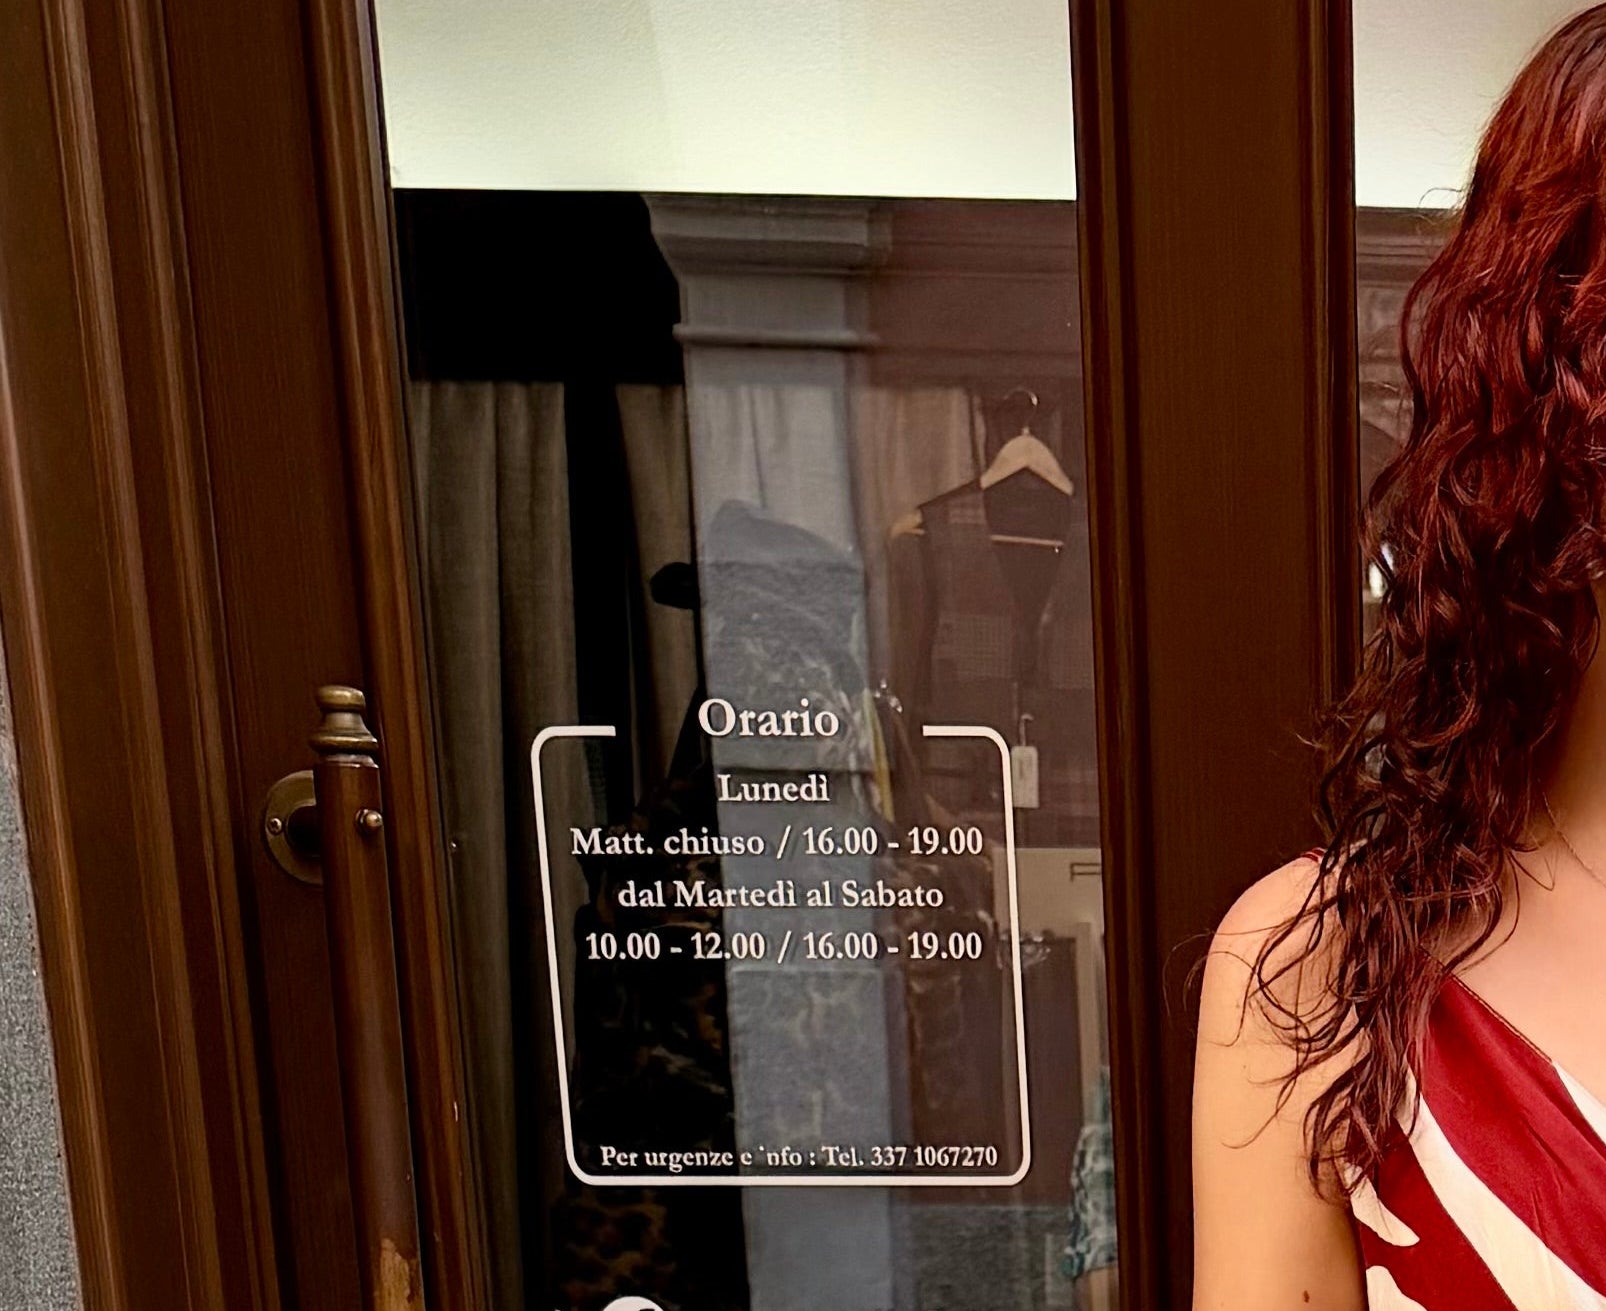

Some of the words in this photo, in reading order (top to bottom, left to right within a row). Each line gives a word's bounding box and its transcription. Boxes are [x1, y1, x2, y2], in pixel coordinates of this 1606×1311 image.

[698, 697, 840, 737] Orario
[717, 773, 830, 802] Lunedì
[570, 827, 654, 855] Matt.
[664, 826, 765, 855] chiuso
[776, 824, 792, 860] /
[802, 826, 878, 855] 16.00
[908, 826, 983, 855] 19.00
[618, 880, 666, 907] dal
[673, 879, 797, 907] Martedì
[806, 879, 834, 907] al
[841, 879, 944, 907] Sabato
[586, 932, 661, 960] 10.00
[690, 931, 765, 960] 12.00
[777, 930, 792, 964] /
[802, 931, 878, 960] 16.00
[907, 931, 982, 960] 19.00
[600, 1146, 638, 1167] Per
[644, 1151, 734, 1173] urgenze
[740, 1152, 753, 1166] e
[759, 1145, 803, 1166] nfo
[820, 1145, 865, 1167] Tel.
[870, 1145, 907, 1167] 337
[913, 1145, 998, 1167] 1067270
